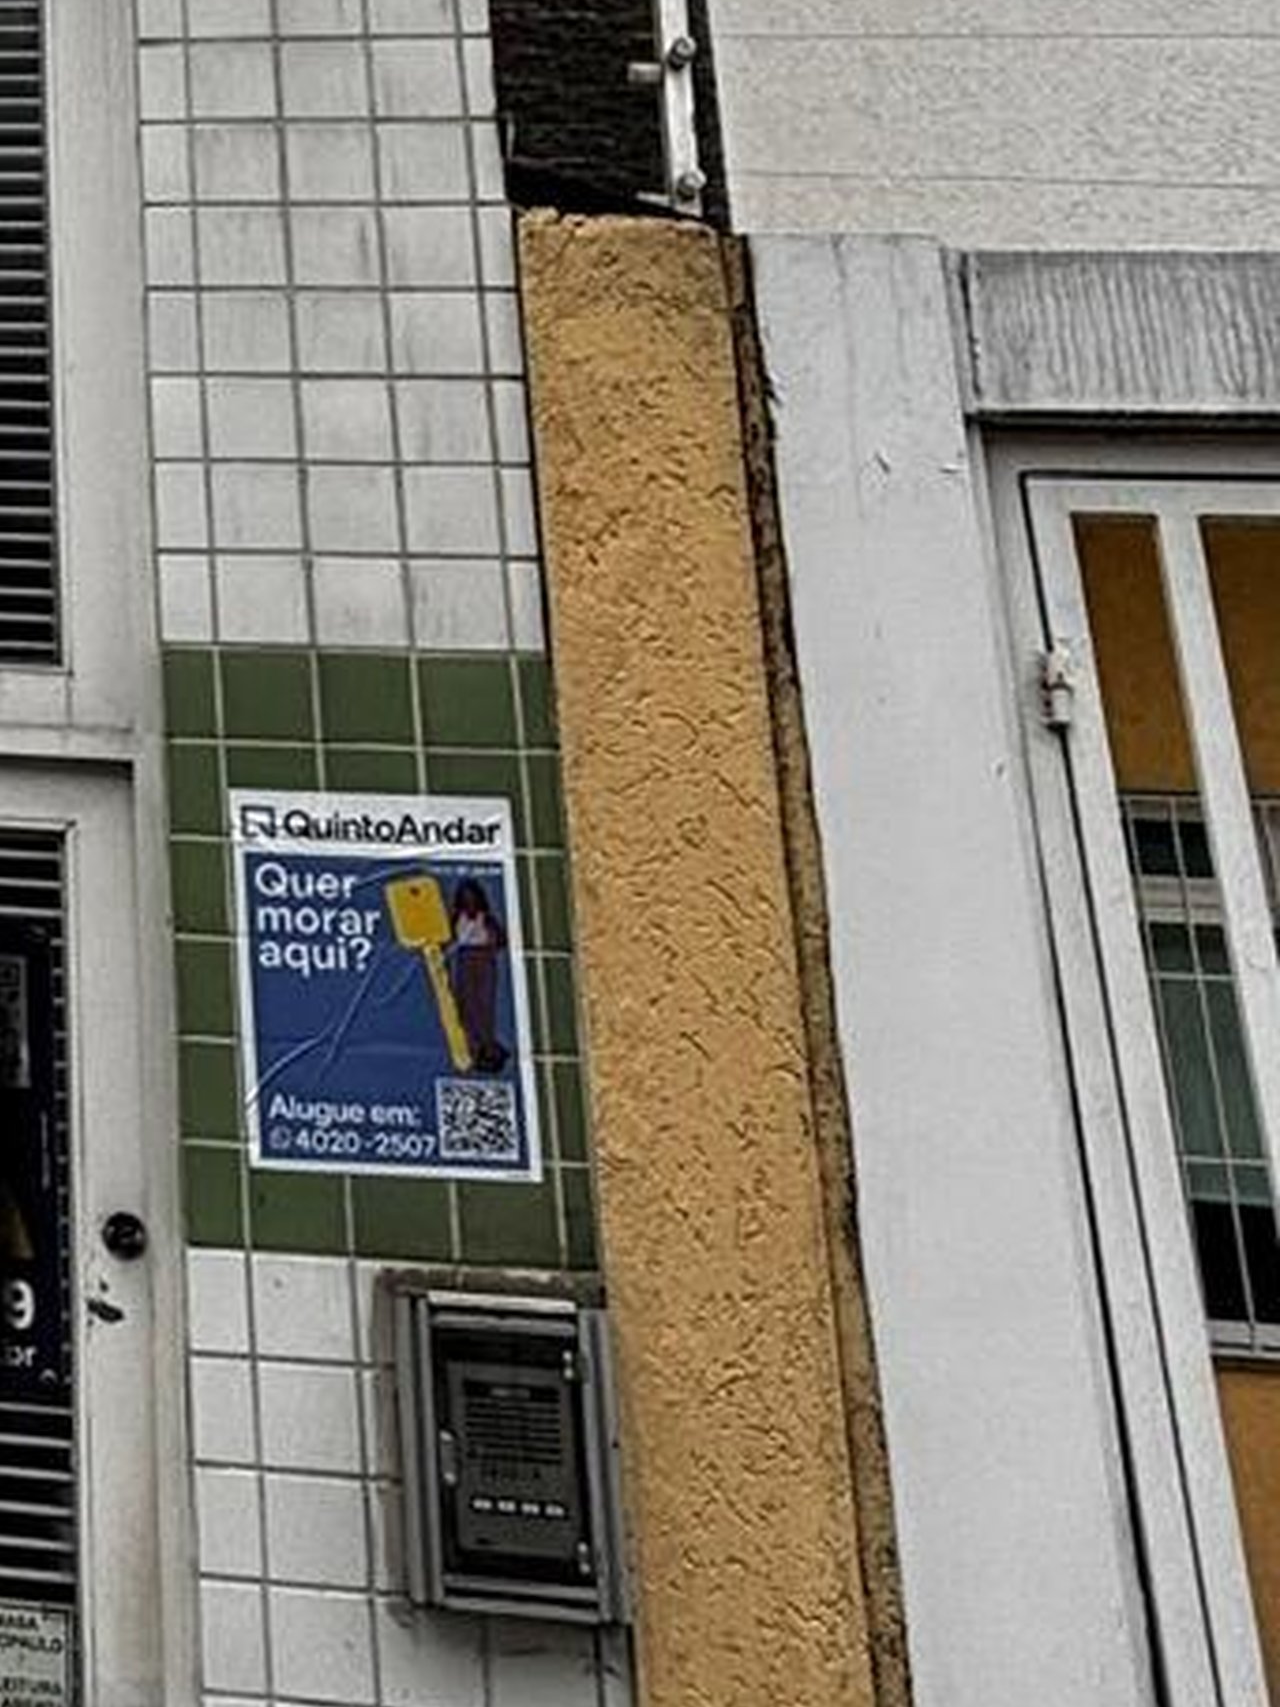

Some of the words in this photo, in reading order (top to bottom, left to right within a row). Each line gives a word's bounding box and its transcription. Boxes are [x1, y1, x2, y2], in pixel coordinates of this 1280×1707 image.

[282, 809, 501, 846] QuintoAndar
[254, 861, 358, 900] Quer
[256, 905, 381, 938] morar
[258, 936, 373, 977] aqui?
[268, 1093, 366, 1129] Alugue
[370, 1102, 422, 1126] em:
